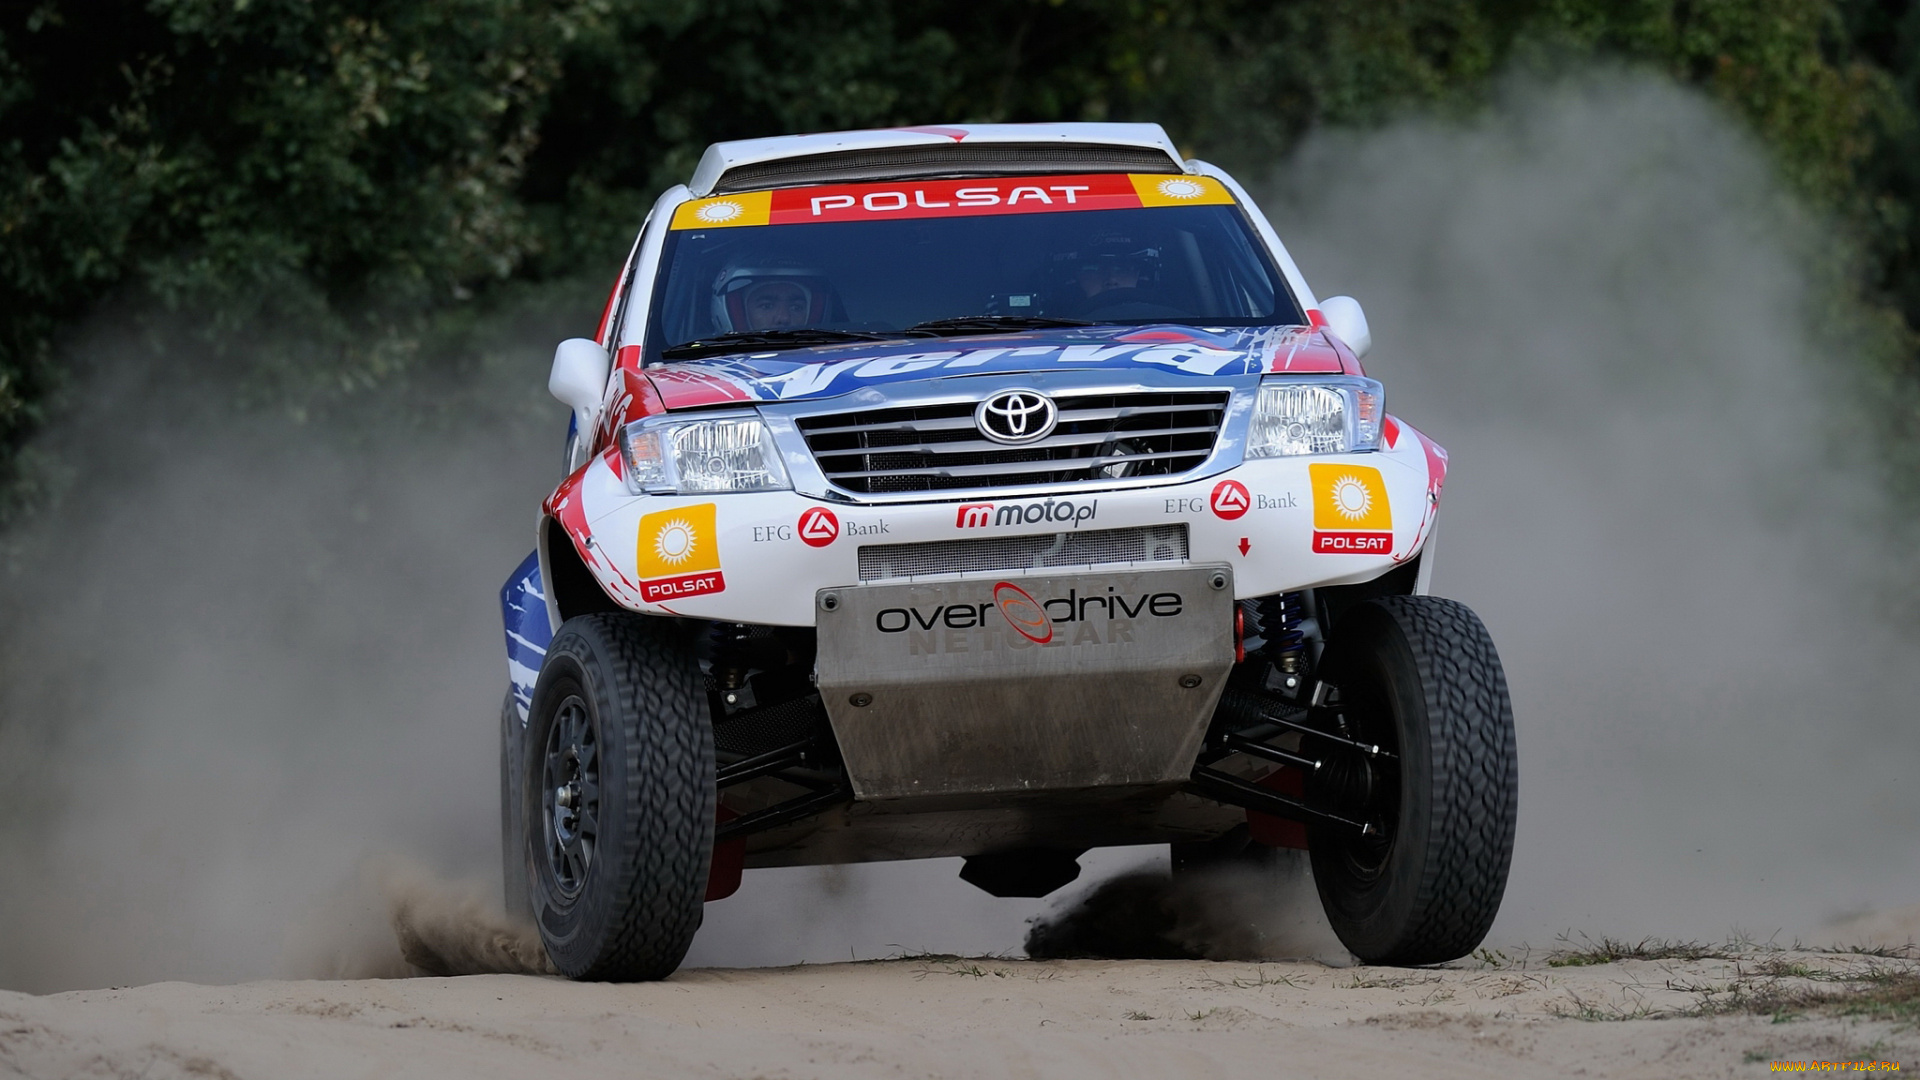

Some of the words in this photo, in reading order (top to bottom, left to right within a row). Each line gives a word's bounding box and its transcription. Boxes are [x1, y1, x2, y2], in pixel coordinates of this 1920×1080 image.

[811, 186, 1090, 216] POLSAT
[1164, 498, 1203, 514] EFG
[1256, 492, 1297, 510] Bank
[753, 525, 791, 542] EFG
[846, 518, 890, 537] Bank
[1320, 537, 1387, 549] POLSAT
[648, 577, 716, 598] POLSAT
[909, 619, 1136, 657] NETGEAR
